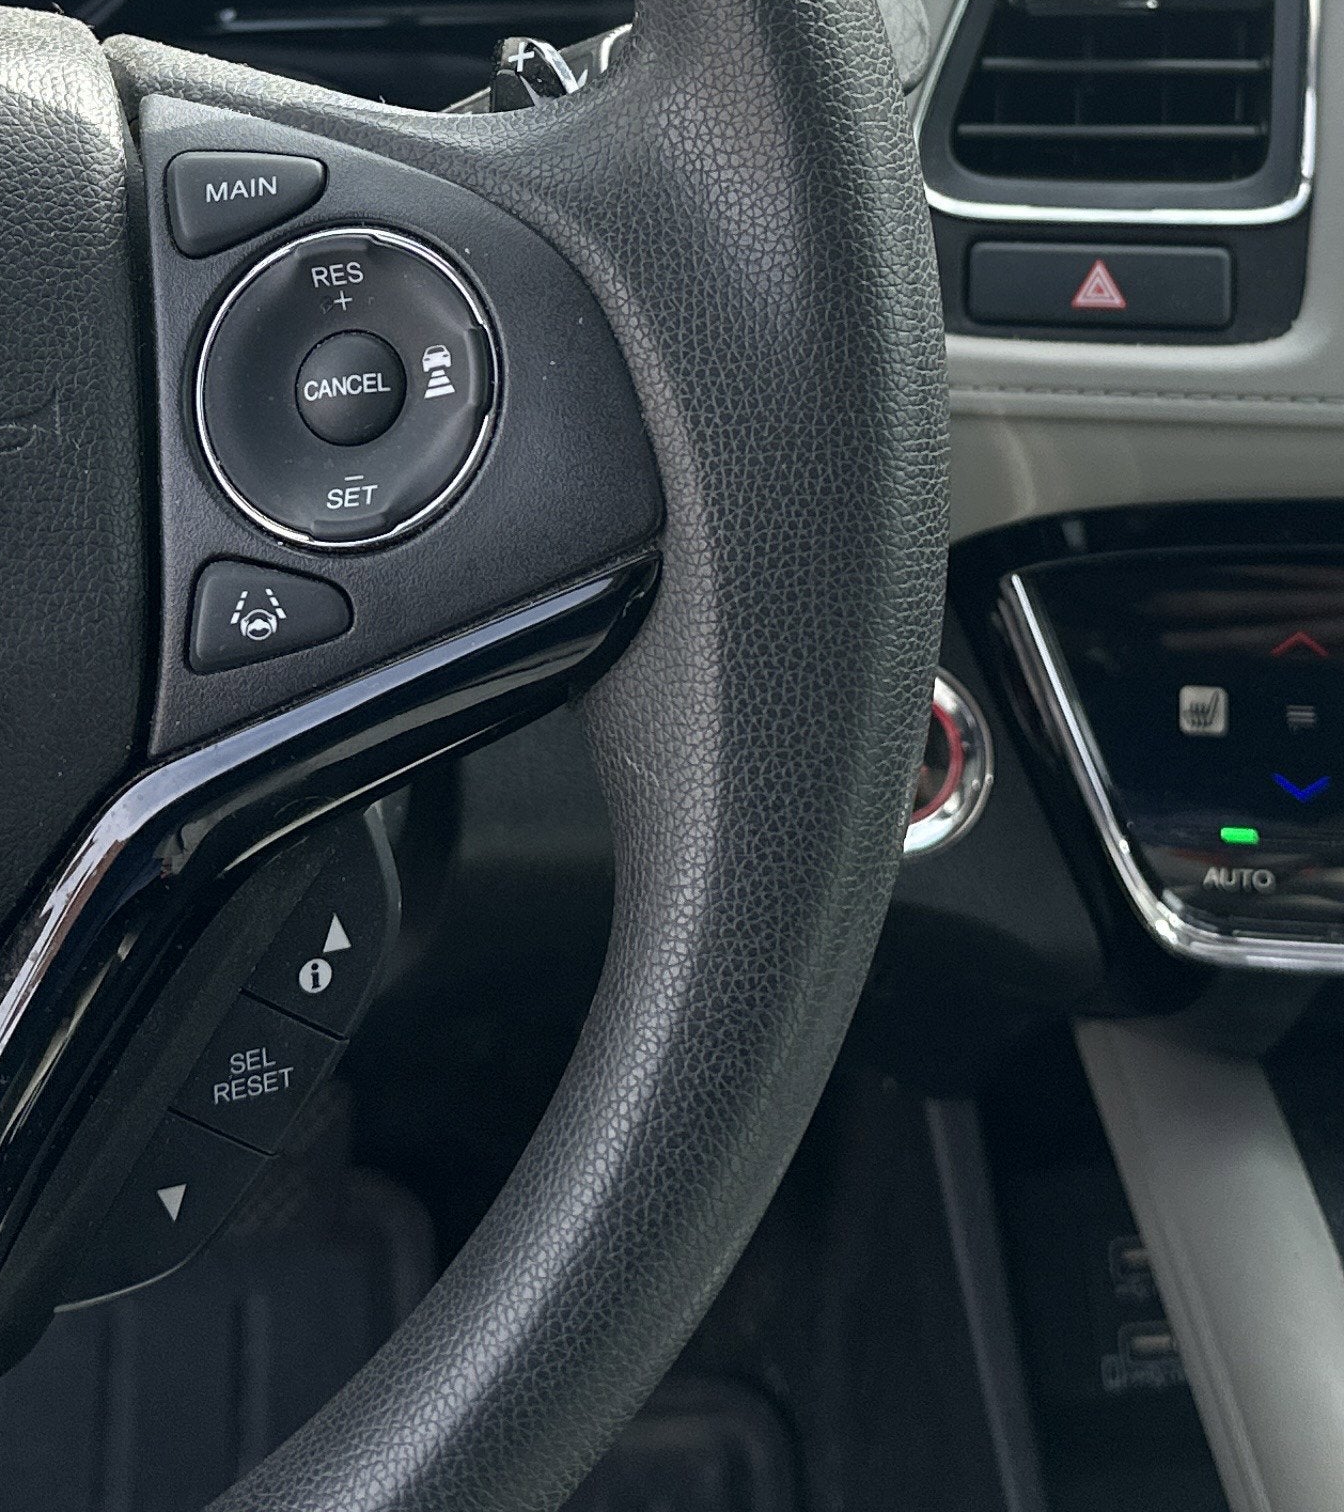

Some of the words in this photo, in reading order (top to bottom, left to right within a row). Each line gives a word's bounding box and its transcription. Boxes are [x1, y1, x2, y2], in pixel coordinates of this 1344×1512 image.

[205, 176, 278, 203] MAIN
[311, 262, 365, 289] RES
[303, 372, 391, 402] CANCEL
[326, 484, 378, 509] SET
[1203, 865, 1275, 893] AUTO
[229, 1047, 277, 1075] SEL
[213, 1066, 294, 1105] RESET
